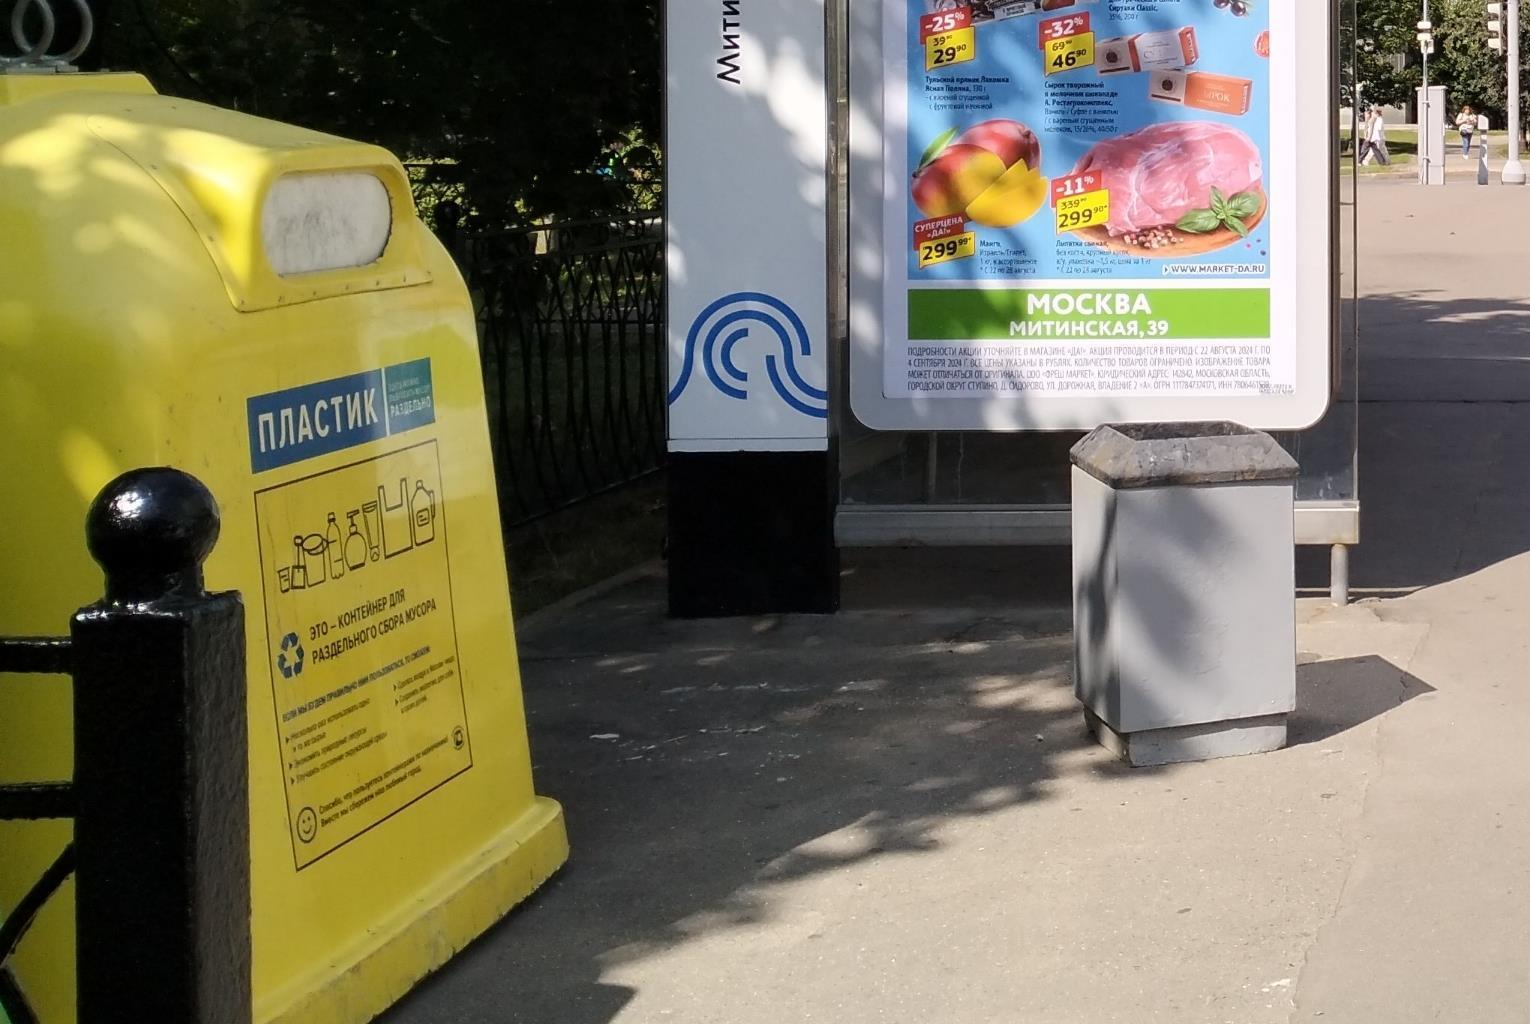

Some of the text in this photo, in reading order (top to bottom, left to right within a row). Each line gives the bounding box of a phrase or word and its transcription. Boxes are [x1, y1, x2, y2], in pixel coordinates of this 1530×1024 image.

[925, 12, 965, 33] -25%
[1044, 17, 1084, 38] -32%
[1056, 176, 1094, 195] -11%
[914, 216, 964, 233] СУПЕРЦЕНА
[1171, 264, 1265, 273] WWW.MARKET-DA.RU
[1027, 293, 1151, 315] МОСКВА
[1009, 320, 1169, 338] МИТИНСКАЯ, 39
[908, 347, 957, 356] ПОДРОБНОСТИ
[958, 347, 982, 356] АКЦИИ
[1030, 347, 1066, 356] МАГАЗИНЕ
[1165, 347, 1193, 356] ПЕРИОД
[1210, 347, 1236, 356] АВГУСТА
[1238, 347, 1253, 356] 2024
[913, 358, 946, 367] СЕНТЯБРЯ
[390, 396, 431, 417] РАЗДЕЛЬНО
[257, 387, 378, 453] ПЛАСТИК
[310, 621, 328, 641] ЭТО
[337, 596, 388, 629] КОНТЕЙНЕР
[389, 588, 406, 607] ДЛЯ
[312, 598, 437, 664] РАЗДЕЛЬНОГО СБОРА МУСОРА
